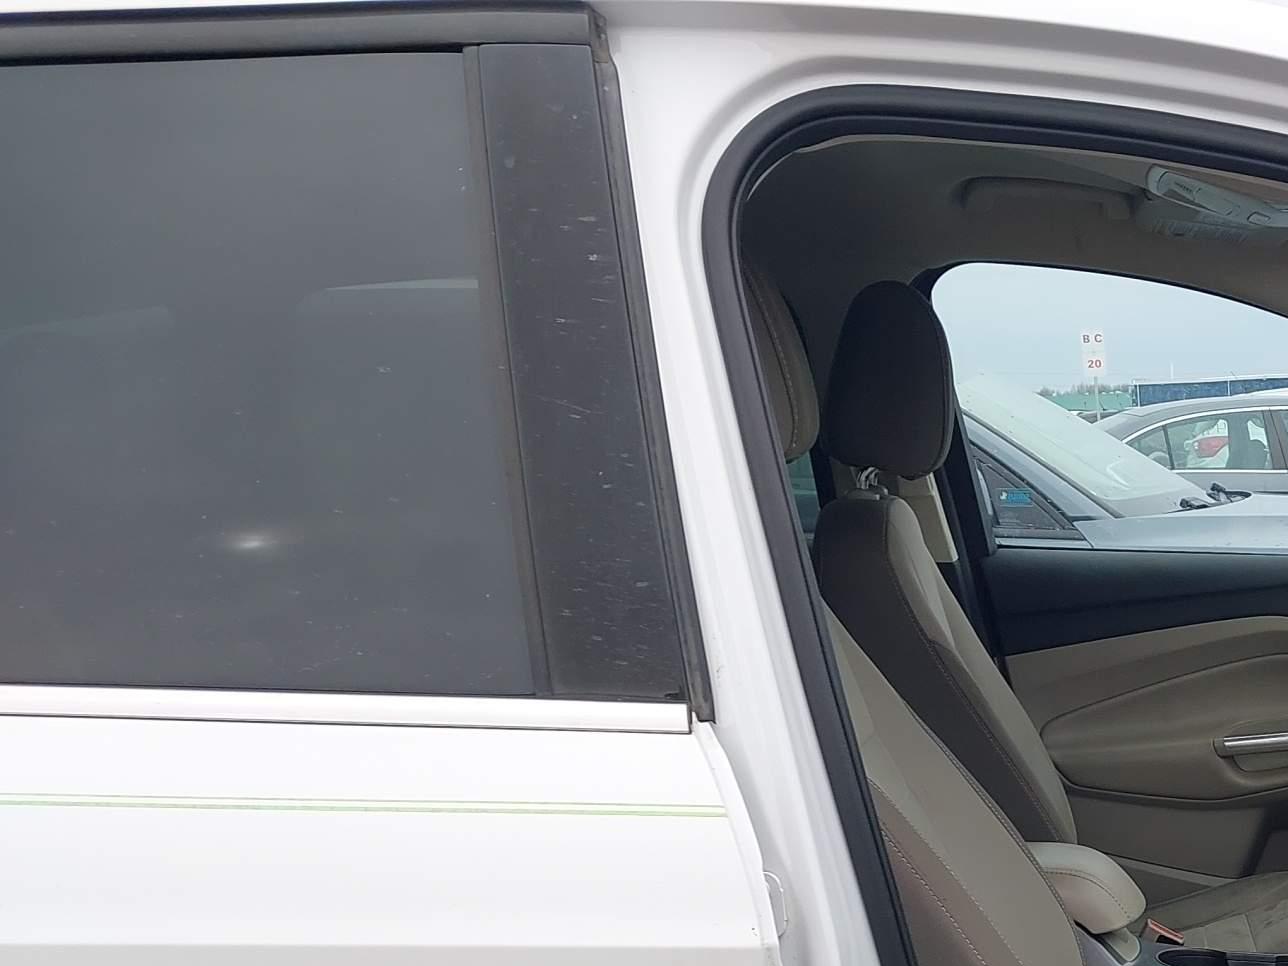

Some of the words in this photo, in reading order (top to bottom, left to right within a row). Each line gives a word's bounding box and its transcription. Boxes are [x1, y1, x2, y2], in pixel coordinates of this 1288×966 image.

[1082, 334, 1090, 344] B
[1094, 333, 1103, 343] C
[1087, 359, 1102, 368] 20
